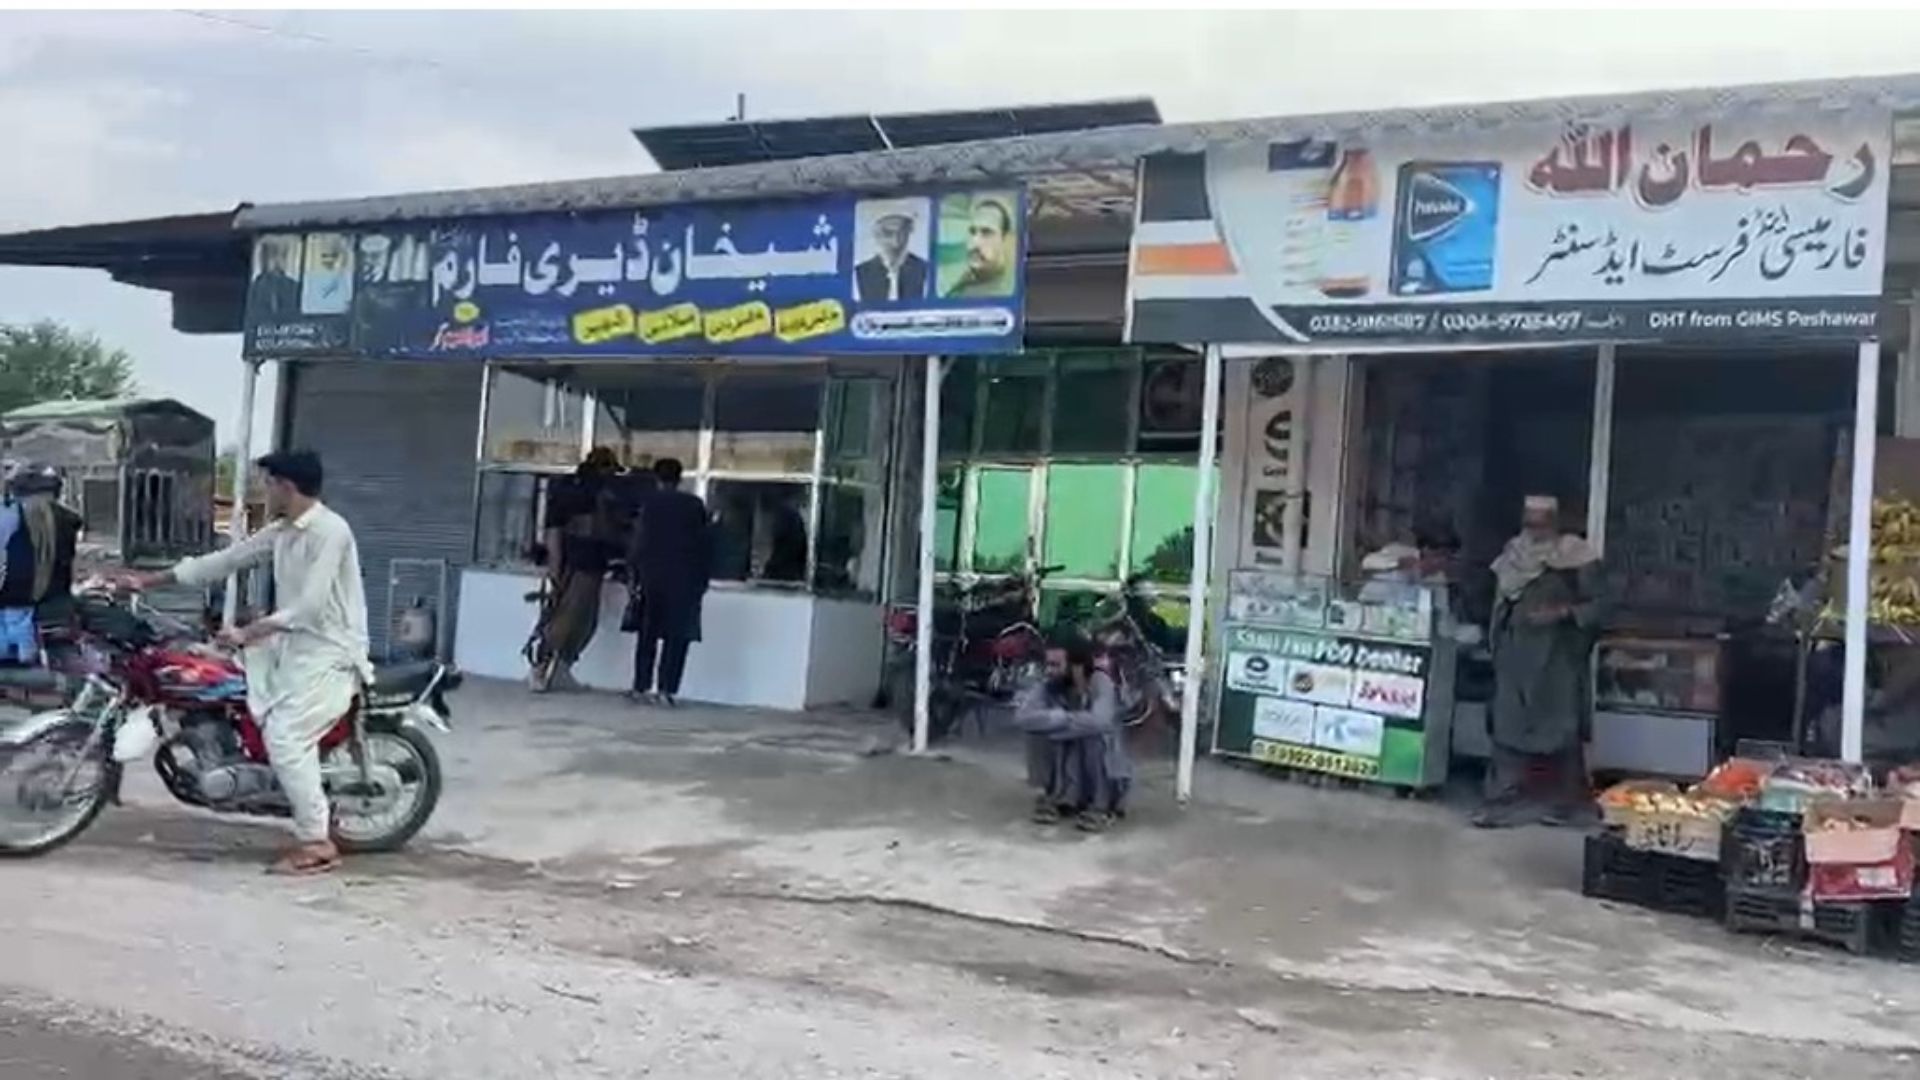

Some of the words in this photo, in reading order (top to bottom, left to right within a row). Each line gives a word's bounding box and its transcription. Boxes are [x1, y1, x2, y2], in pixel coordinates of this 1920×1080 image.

[1633, 123, 1876, 212] رحمان
[431, 232, 522, 308] فارم
[523, 212, 649, 297] ڈیری
[649, 213, 839, 297] شیخان
[1650, 311, 1686, 328] DHT
[1690, 310, 1732, 328] from
[1736, 311, 1783, 328] GIMS
[1787, 309, 1877, 328] Peshawar
